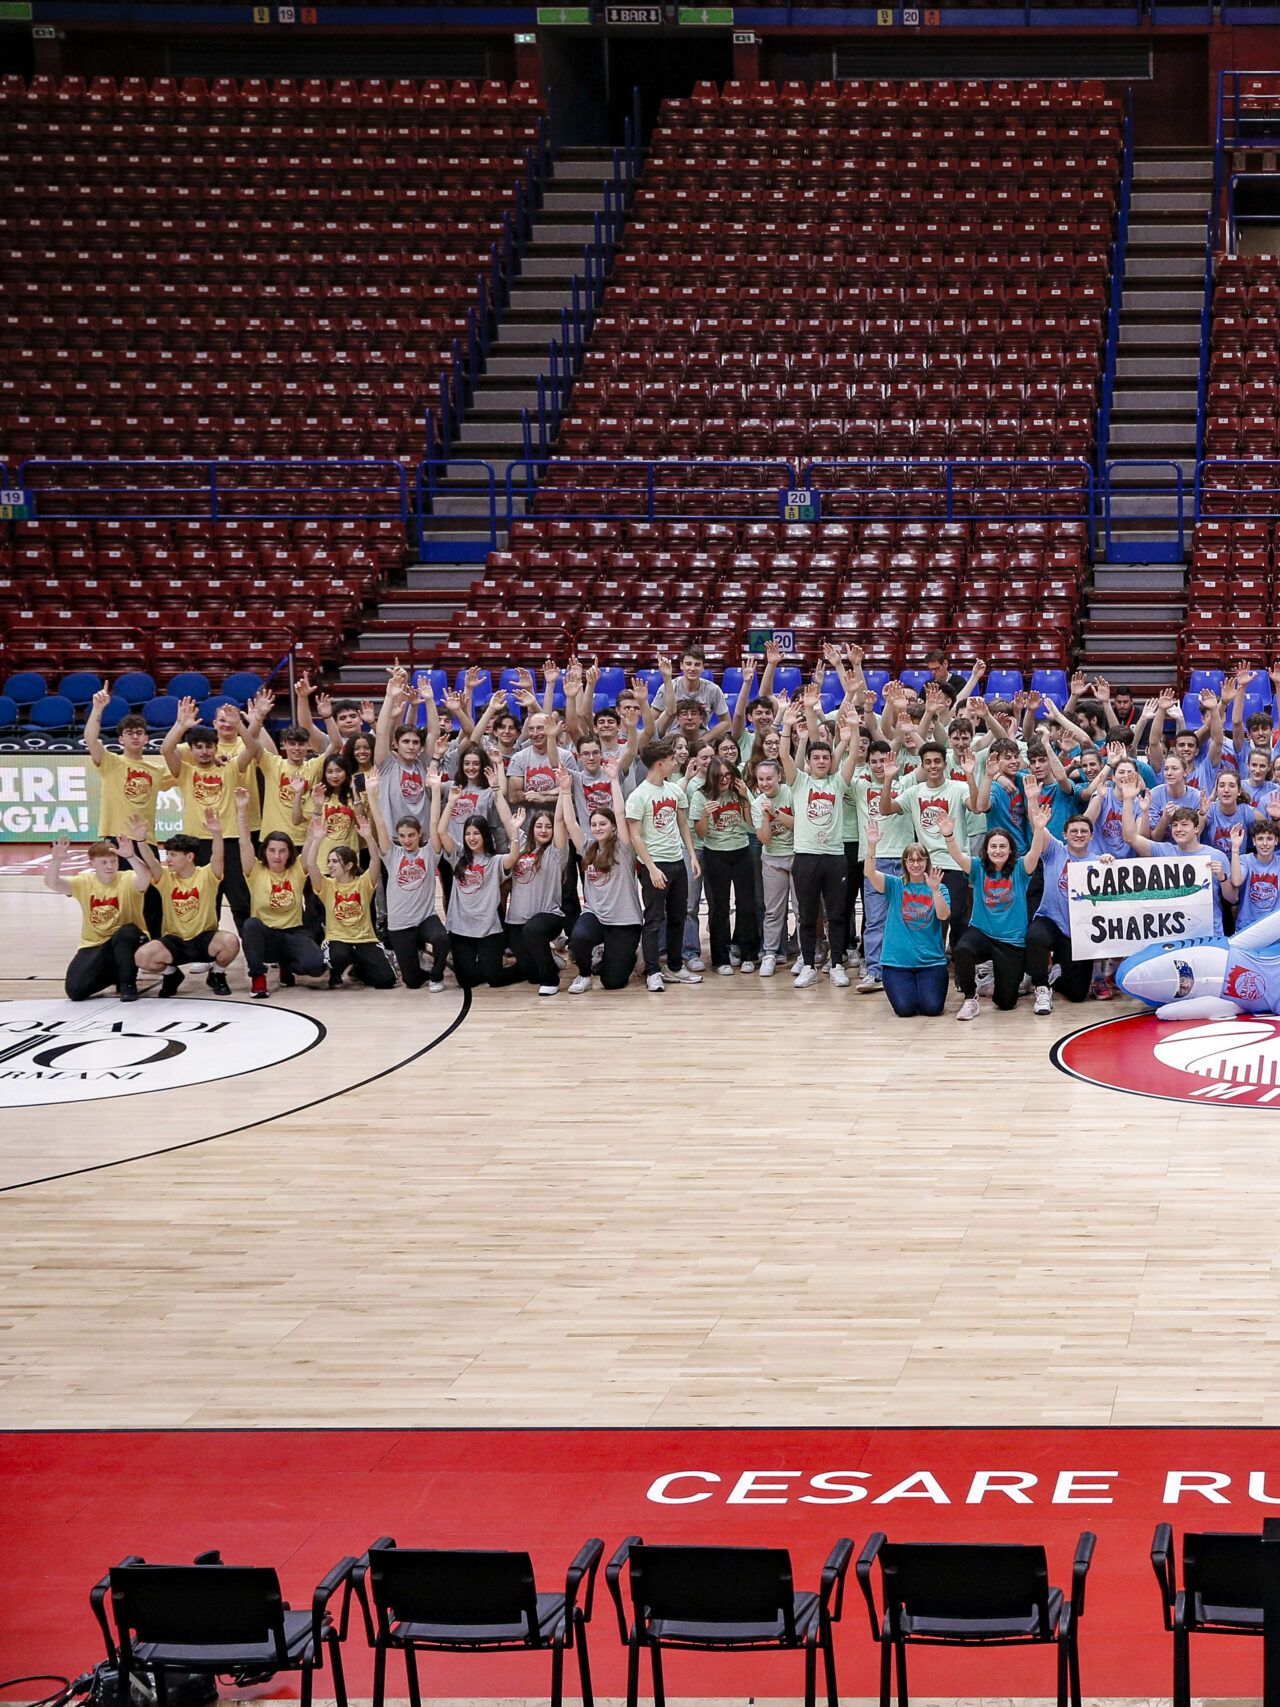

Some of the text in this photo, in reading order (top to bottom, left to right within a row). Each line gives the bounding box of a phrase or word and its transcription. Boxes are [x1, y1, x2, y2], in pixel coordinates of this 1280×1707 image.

[280, 10, 293, 20] 19
[621, 11, 648, 21] BAR
[904, 11, 918, 22] 20
[5, 492, 20, 503] 19
[790, 493, 806, 504] 20
[788, 511, 795, 520] B
[774, 635, 791, 649] 20
[0, 805, 90, 833] GIA!
[1086, 863, 1196, 897] CARDANO
[1090, 911, 1186, 944] SHARKS
[153, 1021, 240, 1033] DI
[645, 1469, 1119, 1506] CESARE
